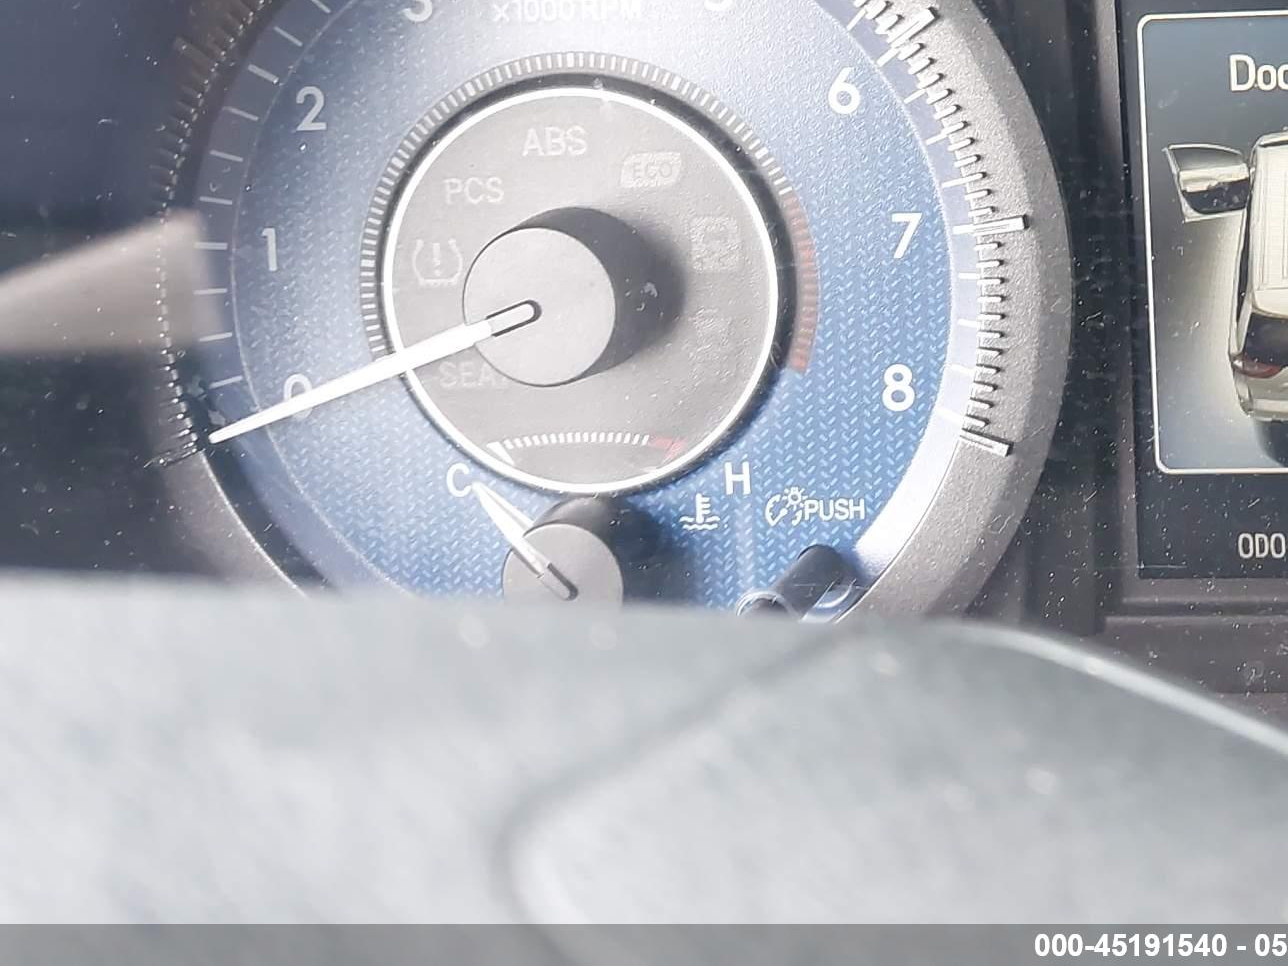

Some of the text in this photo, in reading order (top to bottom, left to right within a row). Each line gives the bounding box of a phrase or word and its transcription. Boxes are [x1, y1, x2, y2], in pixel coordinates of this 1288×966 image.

[295, 85, 327, 131] 2
[827, 67, 860, 114] 6
[522, 125, 586, 155] ABS
[445, 177, 504, 204] PCS
[262, 228, 277, 271] 1
[892, 213, 922, 259] 7
[284, 373, 312, 418] 0
[882, 364, 915, 411] 8
[447, 463, 472, 497] C
[725, 462, 751, 495] H
[805, 498, 866, 521] PUSH
[1237, 532, 1286, 559] ODO
